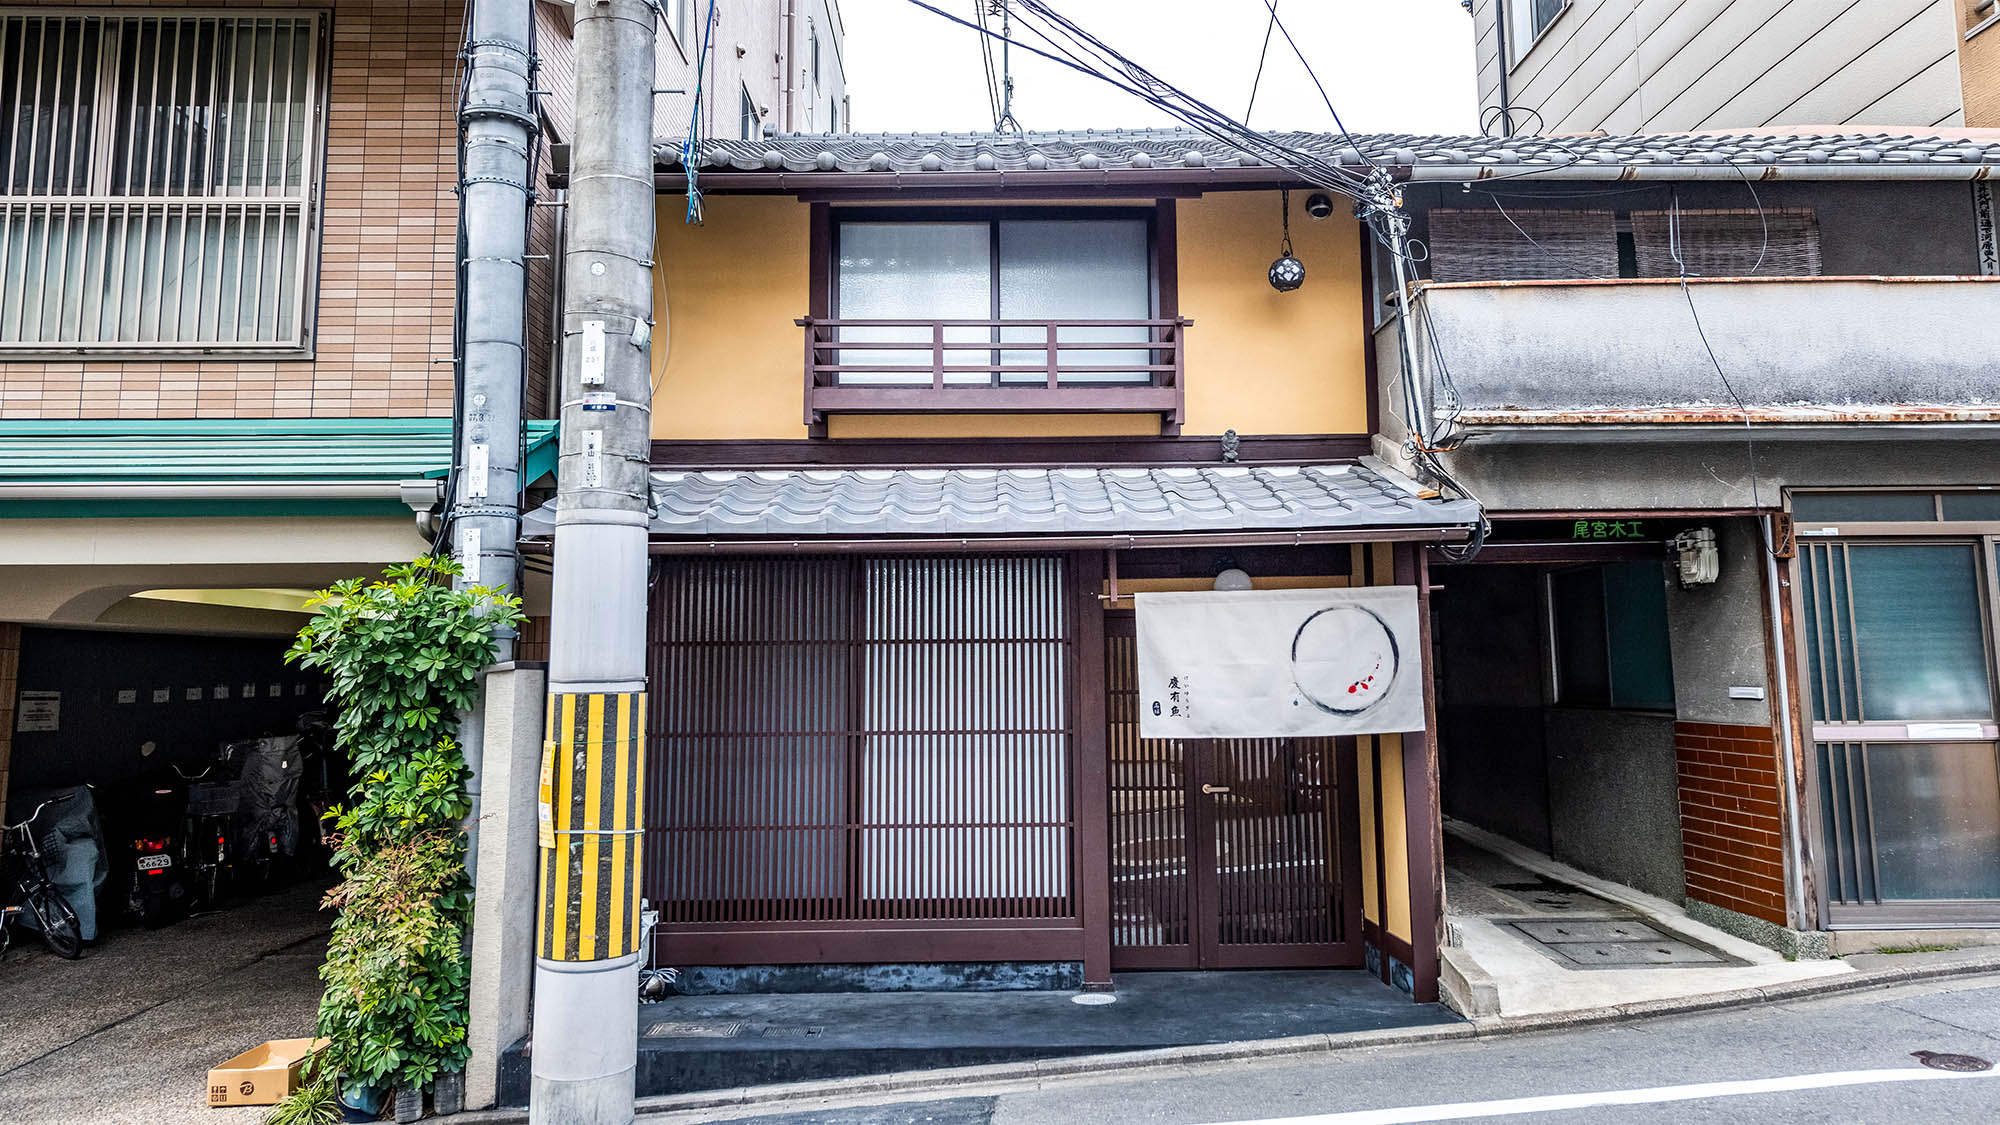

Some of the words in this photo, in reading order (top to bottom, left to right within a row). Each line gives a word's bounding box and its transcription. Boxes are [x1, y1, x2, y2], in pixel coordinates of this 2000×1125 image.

[1572, 520, 1645, 539] 尾宮木工
[1168, 675, 1182, 717] 慶有魚
[145, 858, 169, 868] 6629
